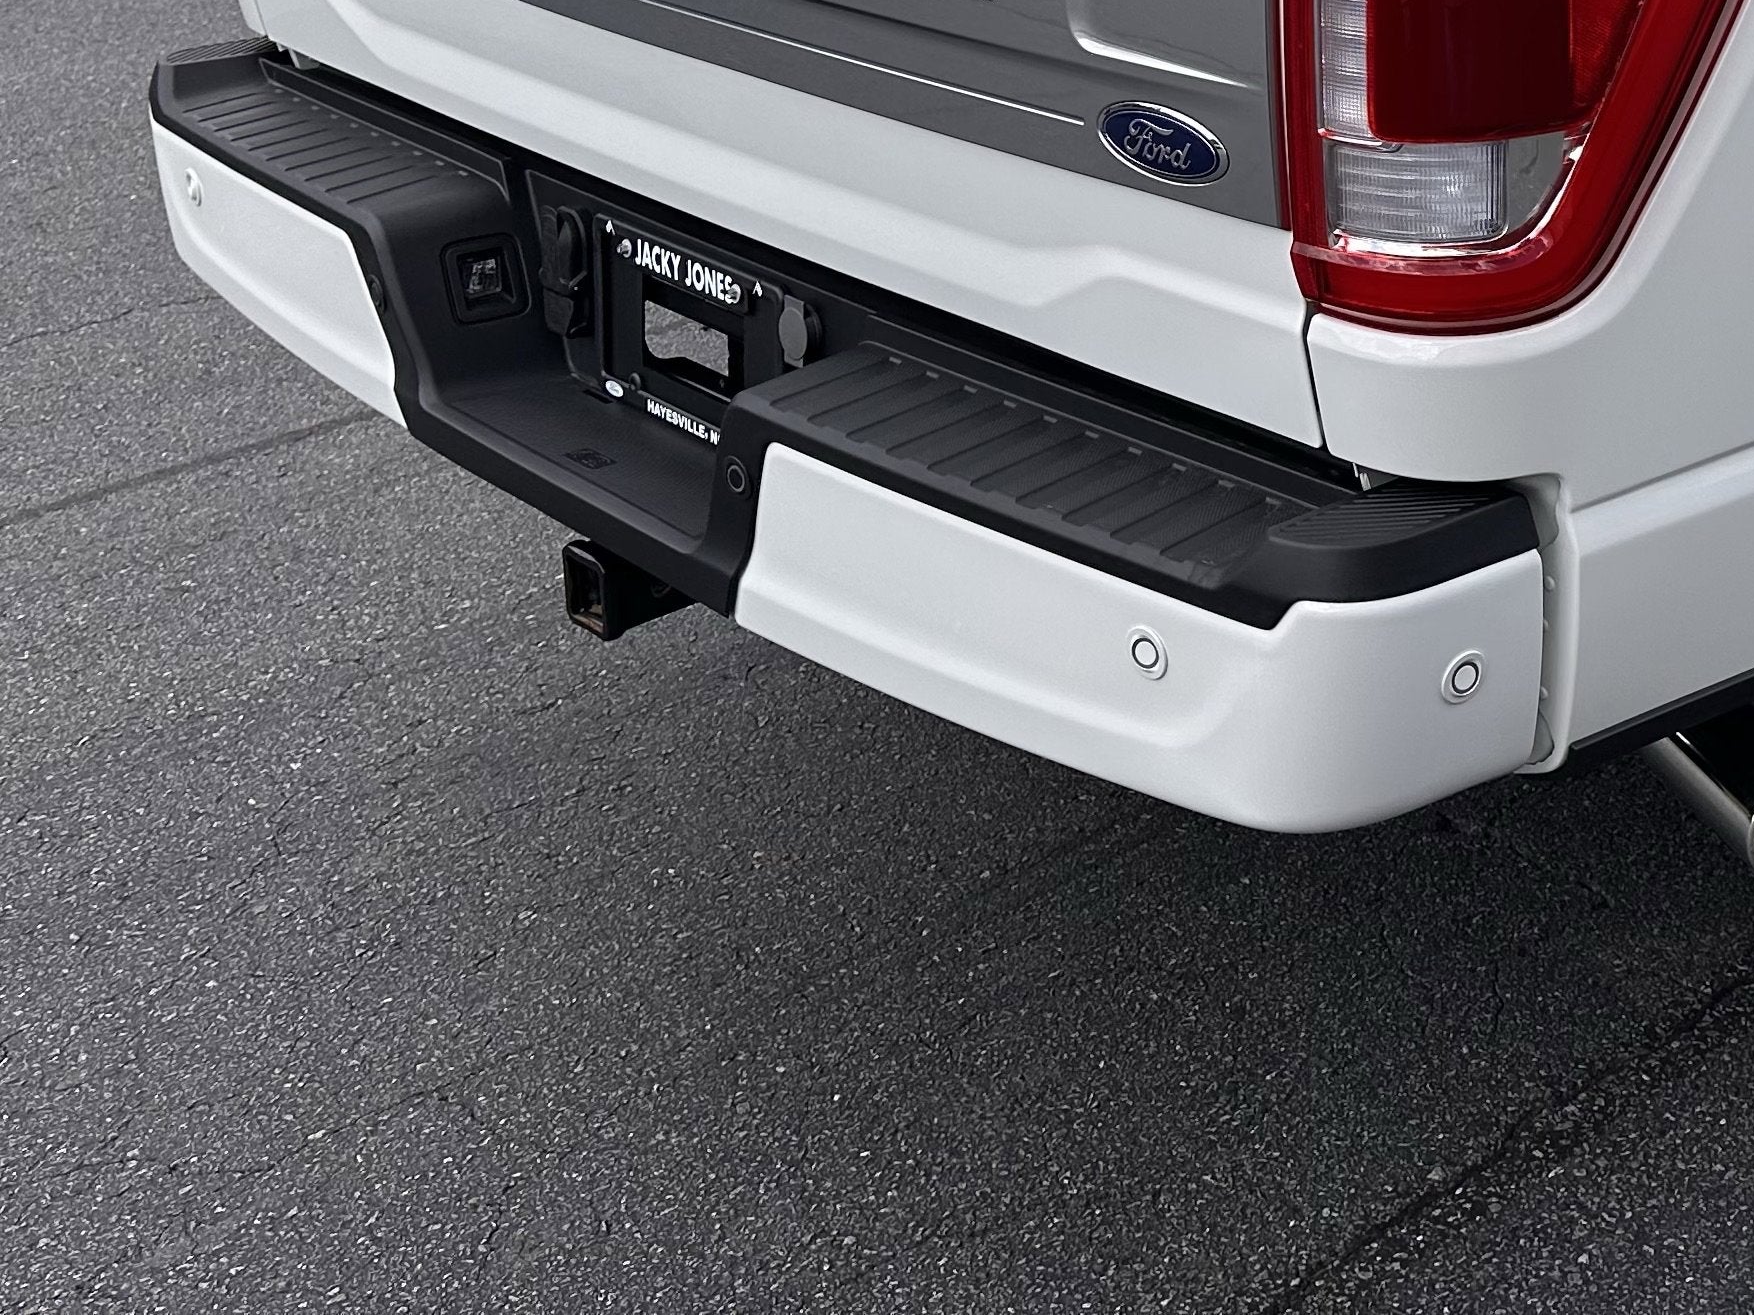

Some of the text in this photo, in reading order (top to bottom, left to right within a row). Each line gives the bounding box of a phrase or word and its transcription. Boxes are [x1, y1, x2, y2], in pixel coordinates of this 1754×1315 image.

[1123, 117, 1192, 170] Ford
[634, 238, 735, 305] JACKY JONES
[647, 398, 720, 445] HAYESVILLE, N
